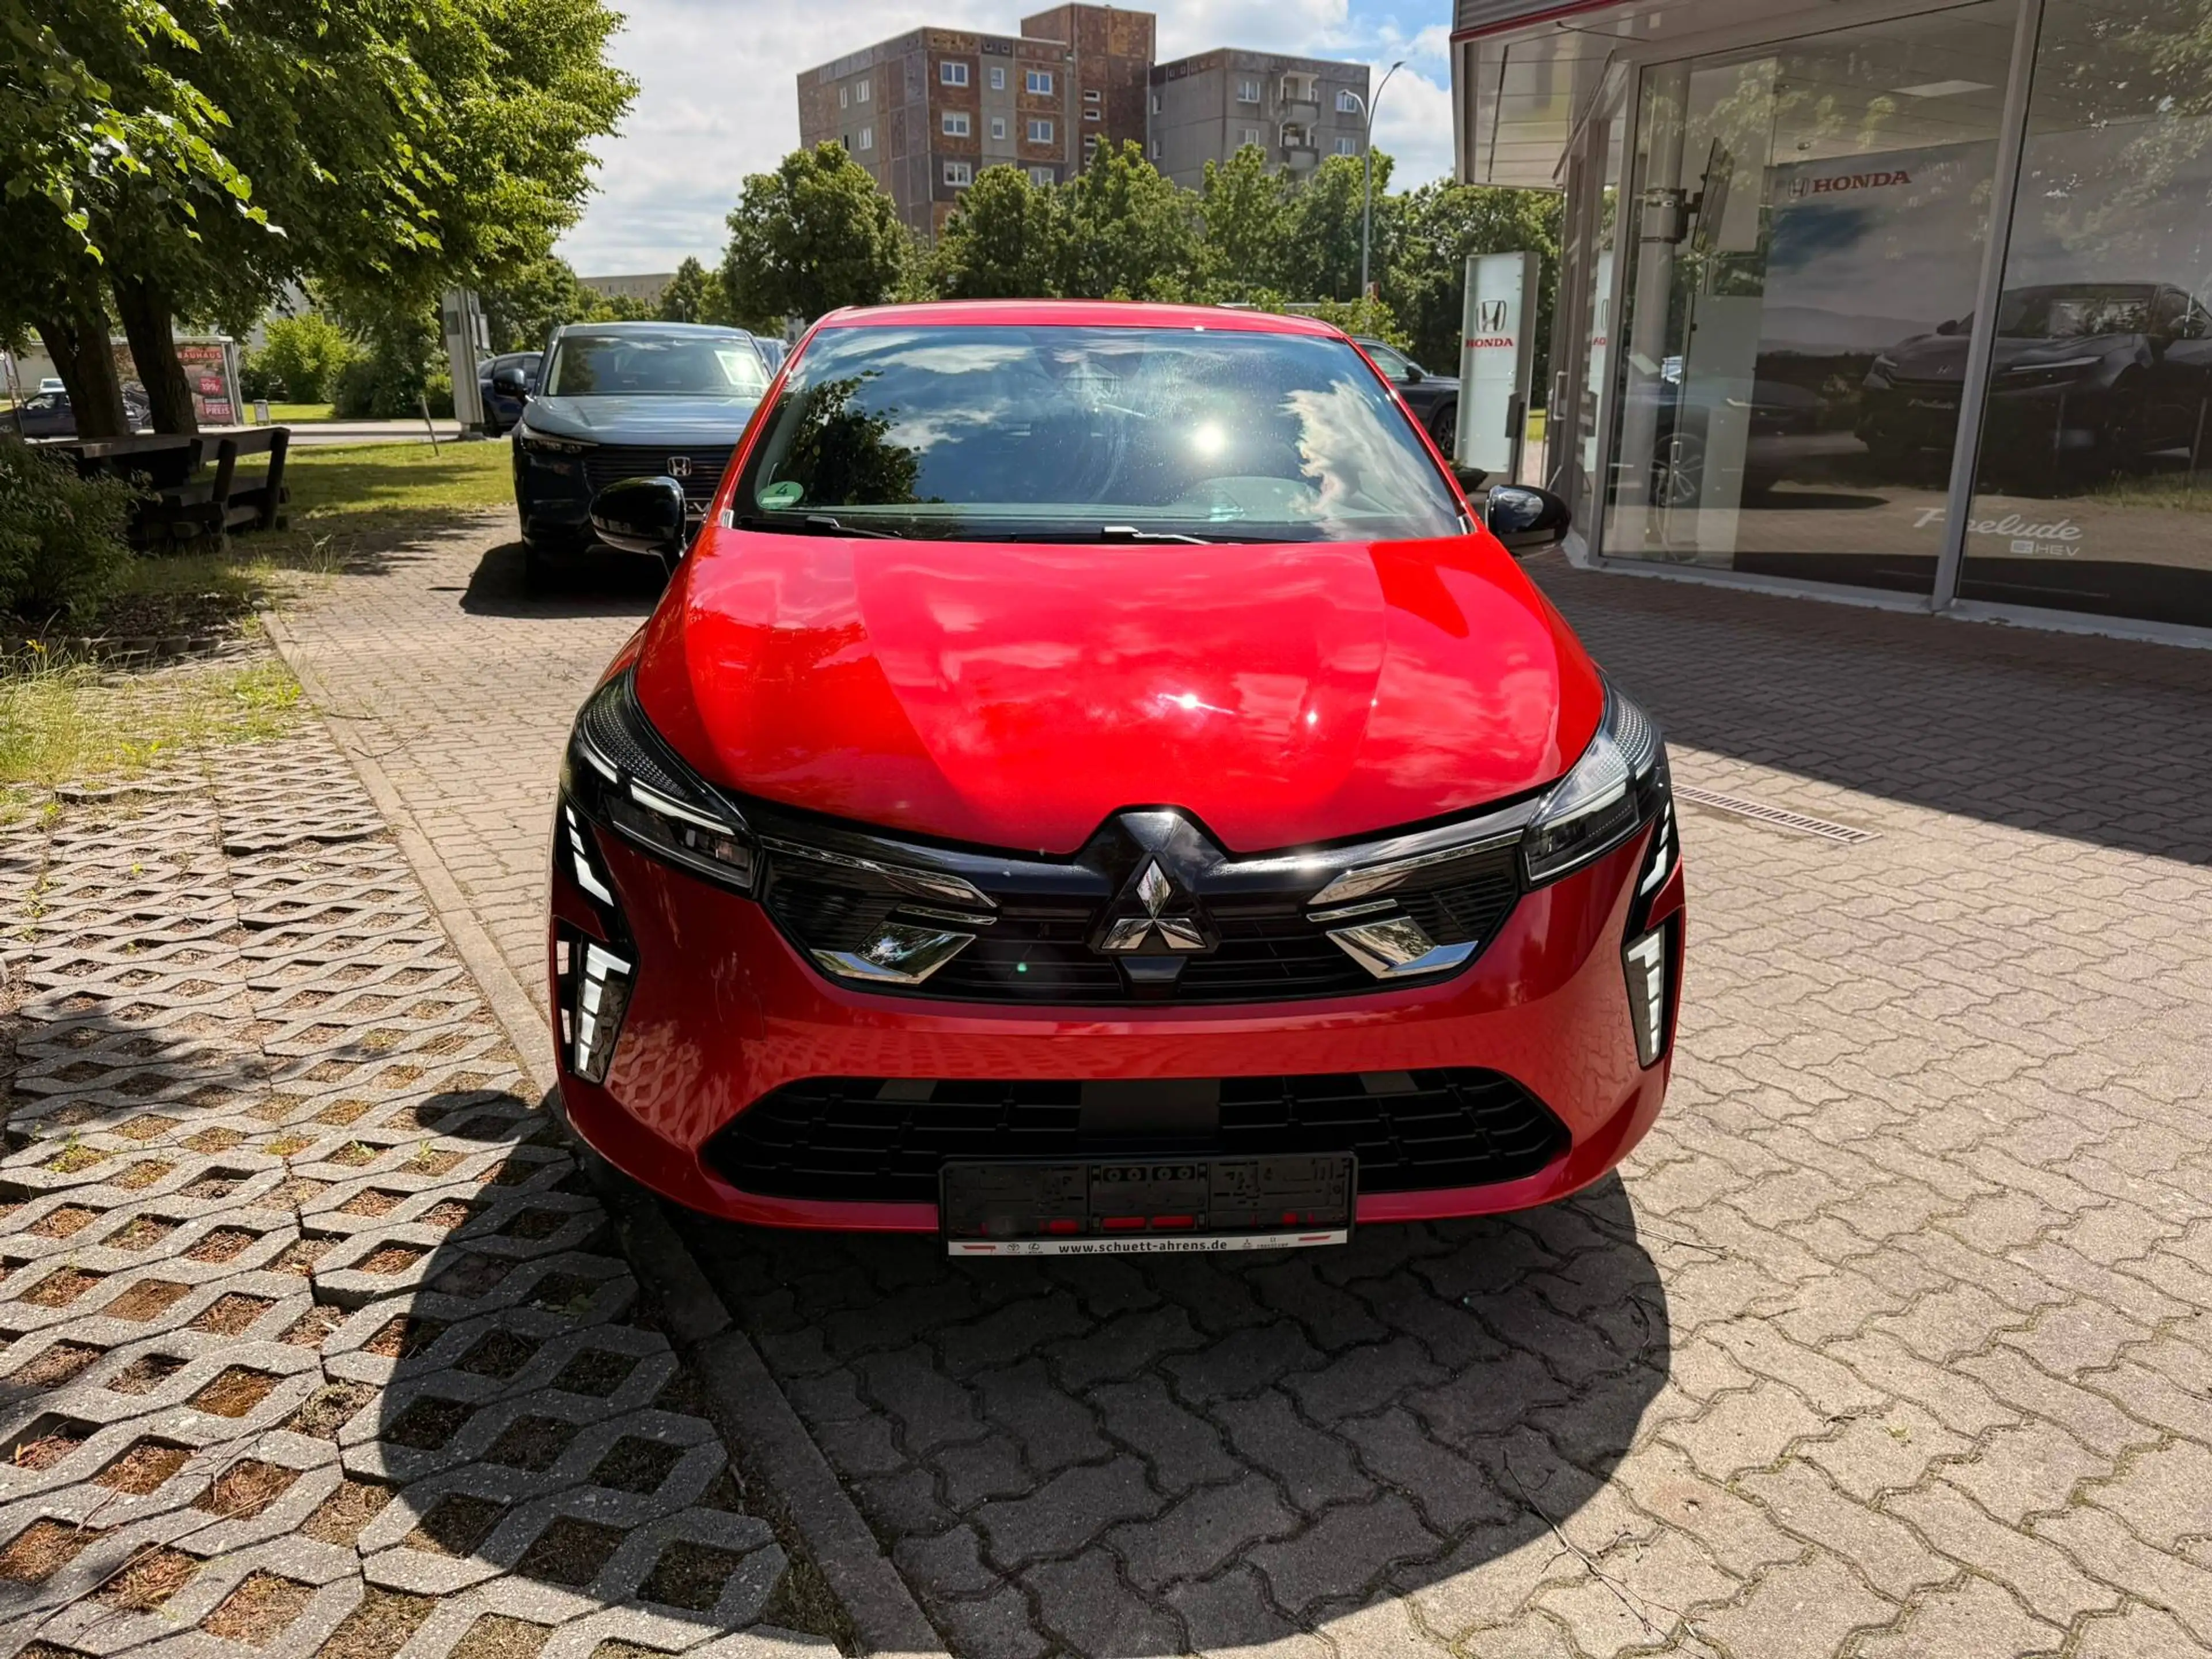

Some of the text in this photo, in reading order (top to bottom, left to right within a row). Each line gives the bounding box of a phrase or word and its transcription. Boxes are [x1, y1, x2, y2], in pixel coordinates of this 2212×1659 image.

[1812, 171, 1912, 194] HONDA
[1465, 338, 1513, 348] HONDA
[176, 350, 222, 359] BAUHAUS
[775, 483, 788, 495] 4
[1058, 1240, 1228, 1253] www.schuett-ahrens.de
